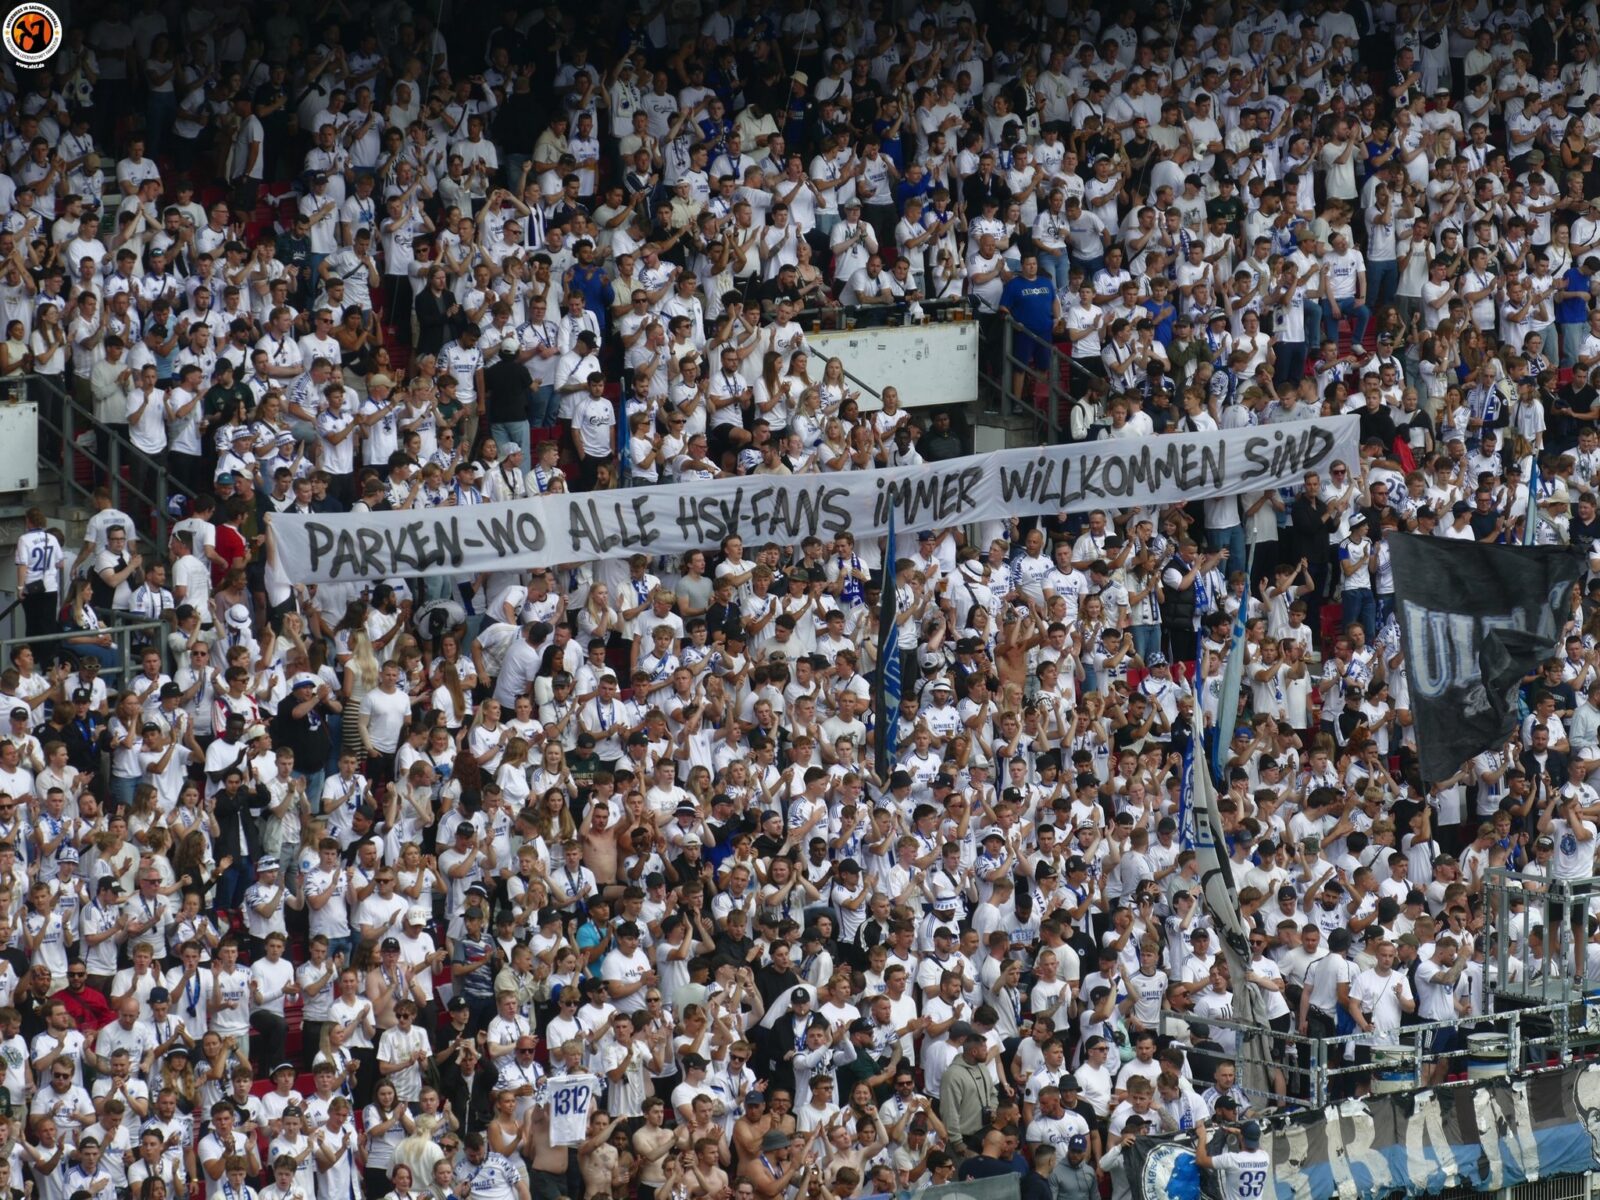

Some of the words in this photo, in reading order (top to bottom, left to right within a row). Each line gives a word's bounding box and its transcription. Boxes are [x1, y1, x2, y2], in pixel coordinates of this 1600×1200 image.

[589, 416, 610, 426] Carlsberg
[305, 509, 546, 579] PARKEN-WO
[568, 495, 660, 552] ALLE
[676, 485, 850, 543] HSV-FANS
[32, 546, 54, 572] 27
[552, 1085, 590, 1118] 1312
[1239, 1170, 1266, 1197] 33
